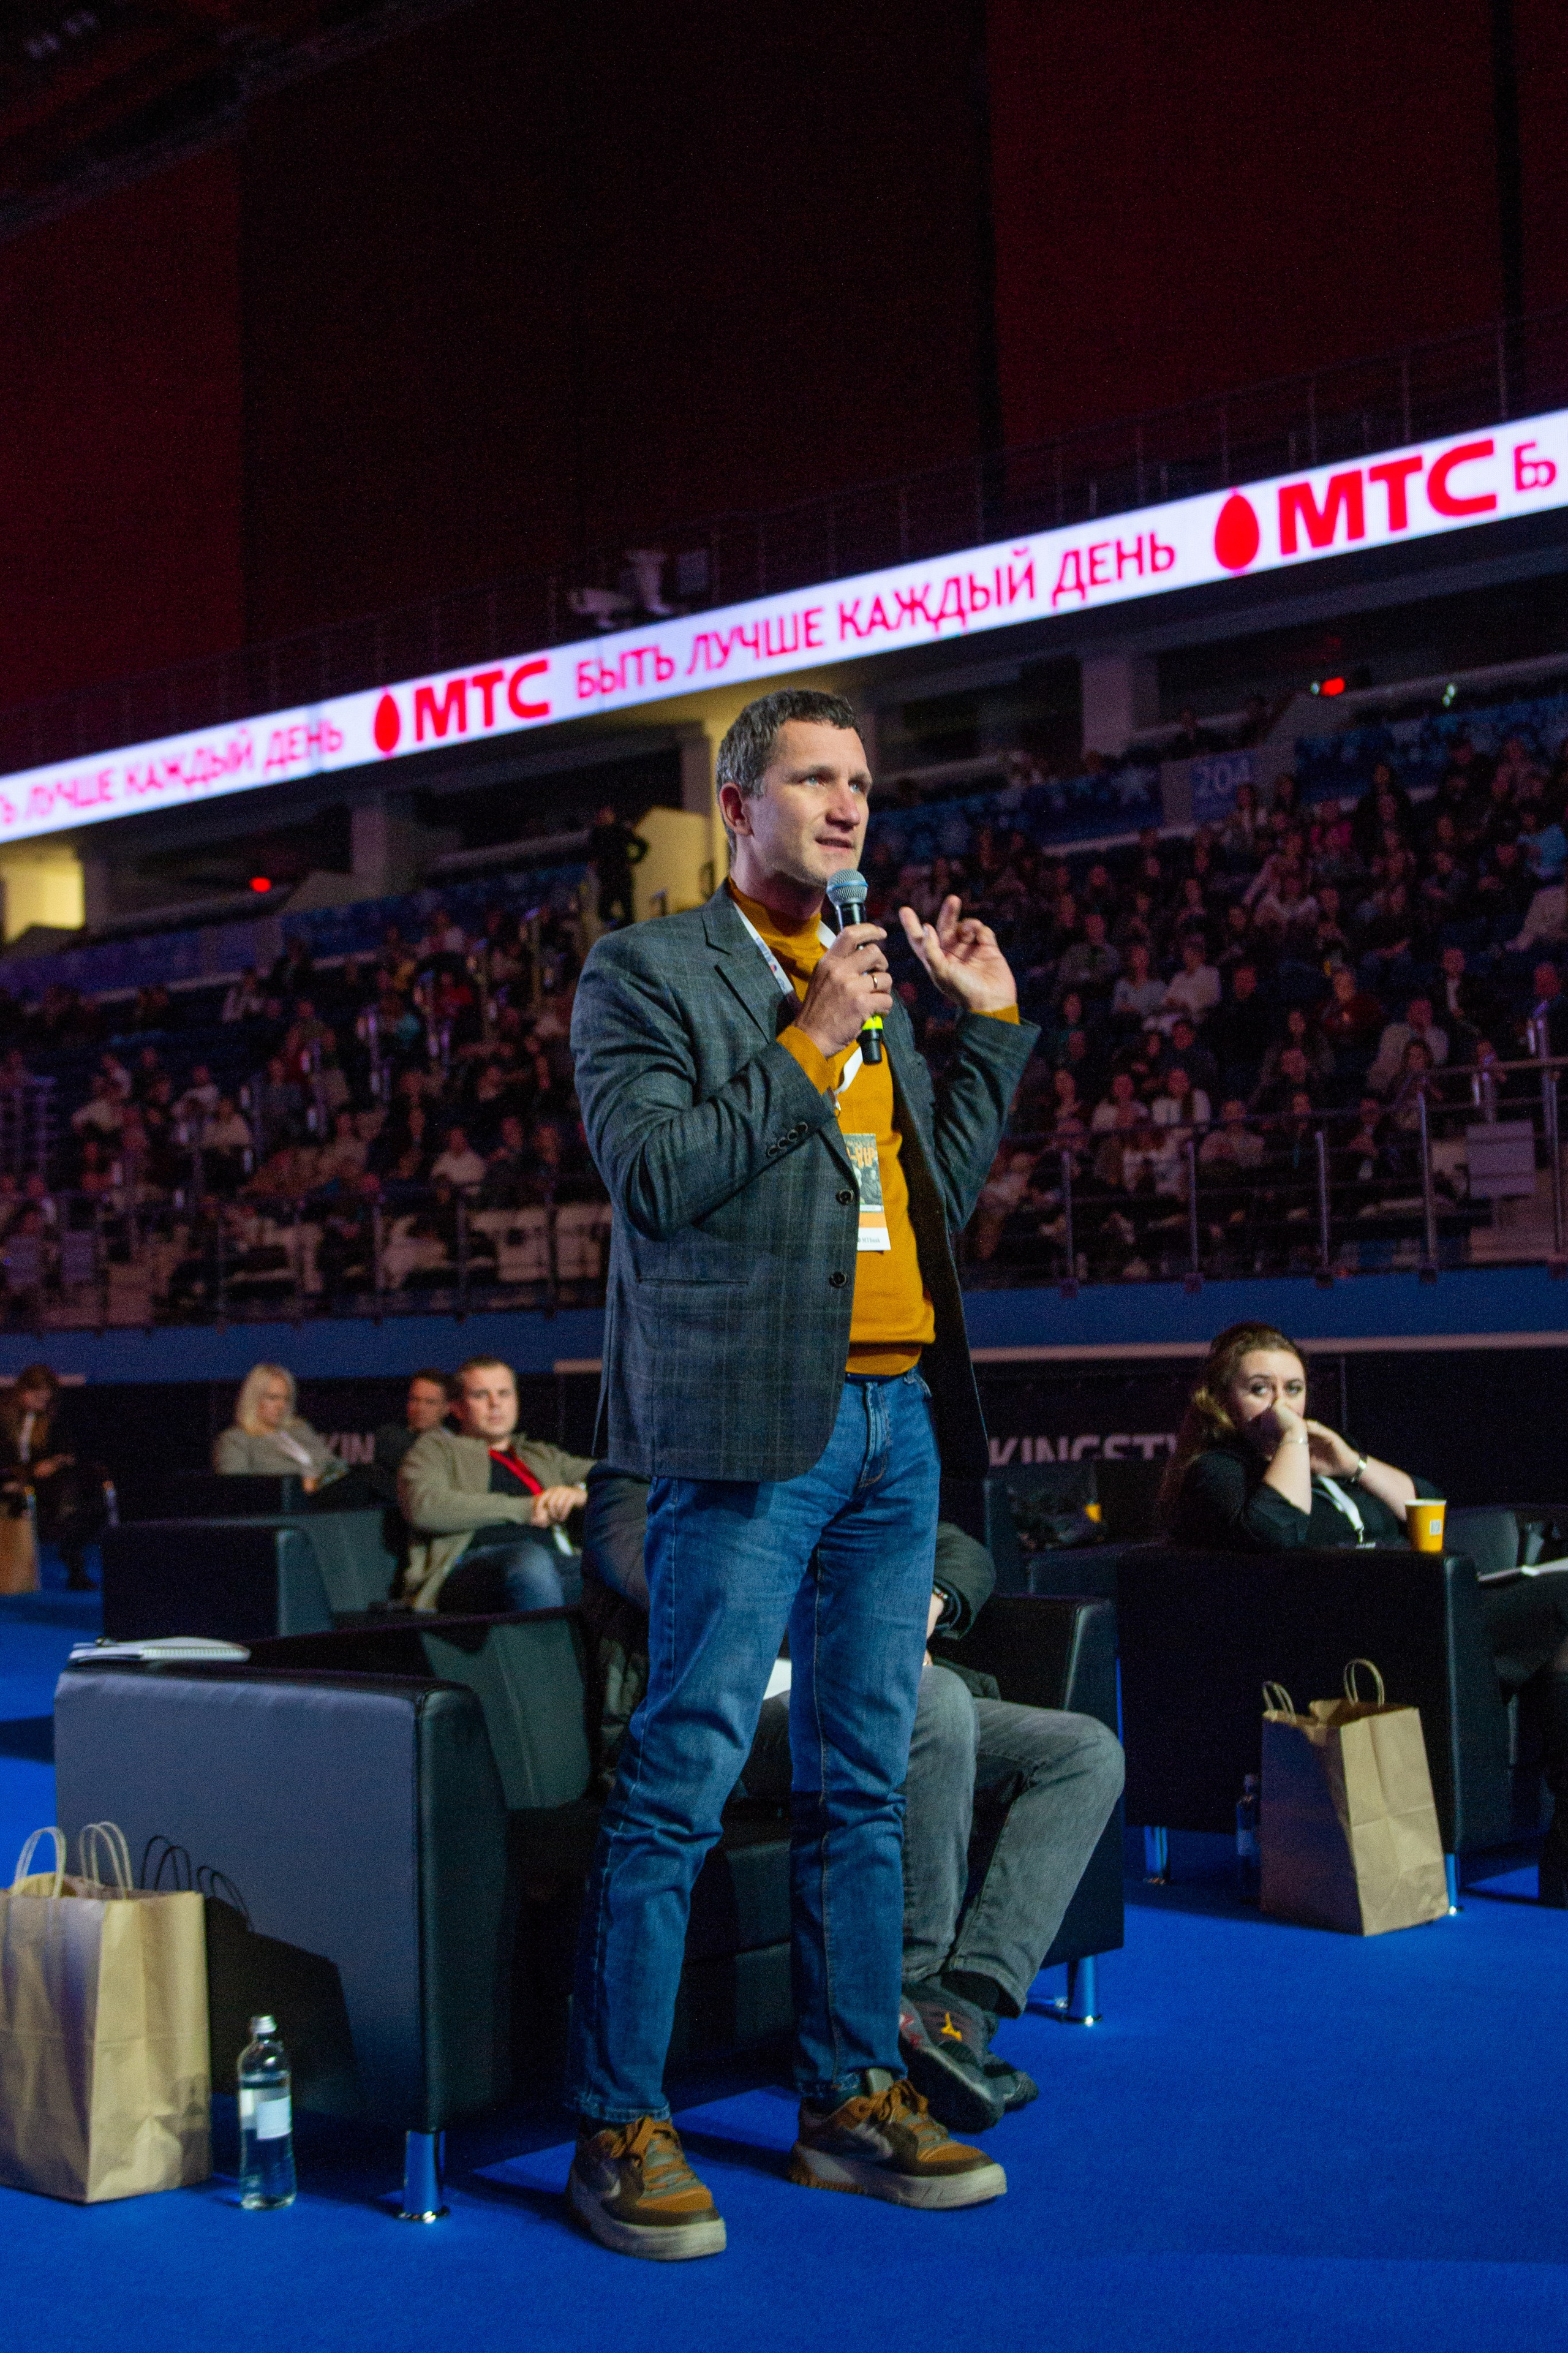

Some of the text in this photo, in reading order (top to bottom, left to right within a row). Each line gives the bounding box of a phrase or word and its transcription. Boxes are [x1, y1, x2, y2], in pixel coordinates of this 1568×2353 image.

[27, 769, 114, 815] ЛУЧШЕ
[126, 729, 252, 794] КАЖДЫЙ
[264, 721, 343, 774] ДЕНЬ
[413, 658, 552, 742] МТС
[576, 645, 676, 700] БЫТЬ
[686, 607, 824, 675] ЛУЧШЕ
[839, 548, 1036, 641] КАЖДЫЙ
[1050, 531, 1176, 608] ДЕНЬ
[1278, 438, 1498, 557] МТС
